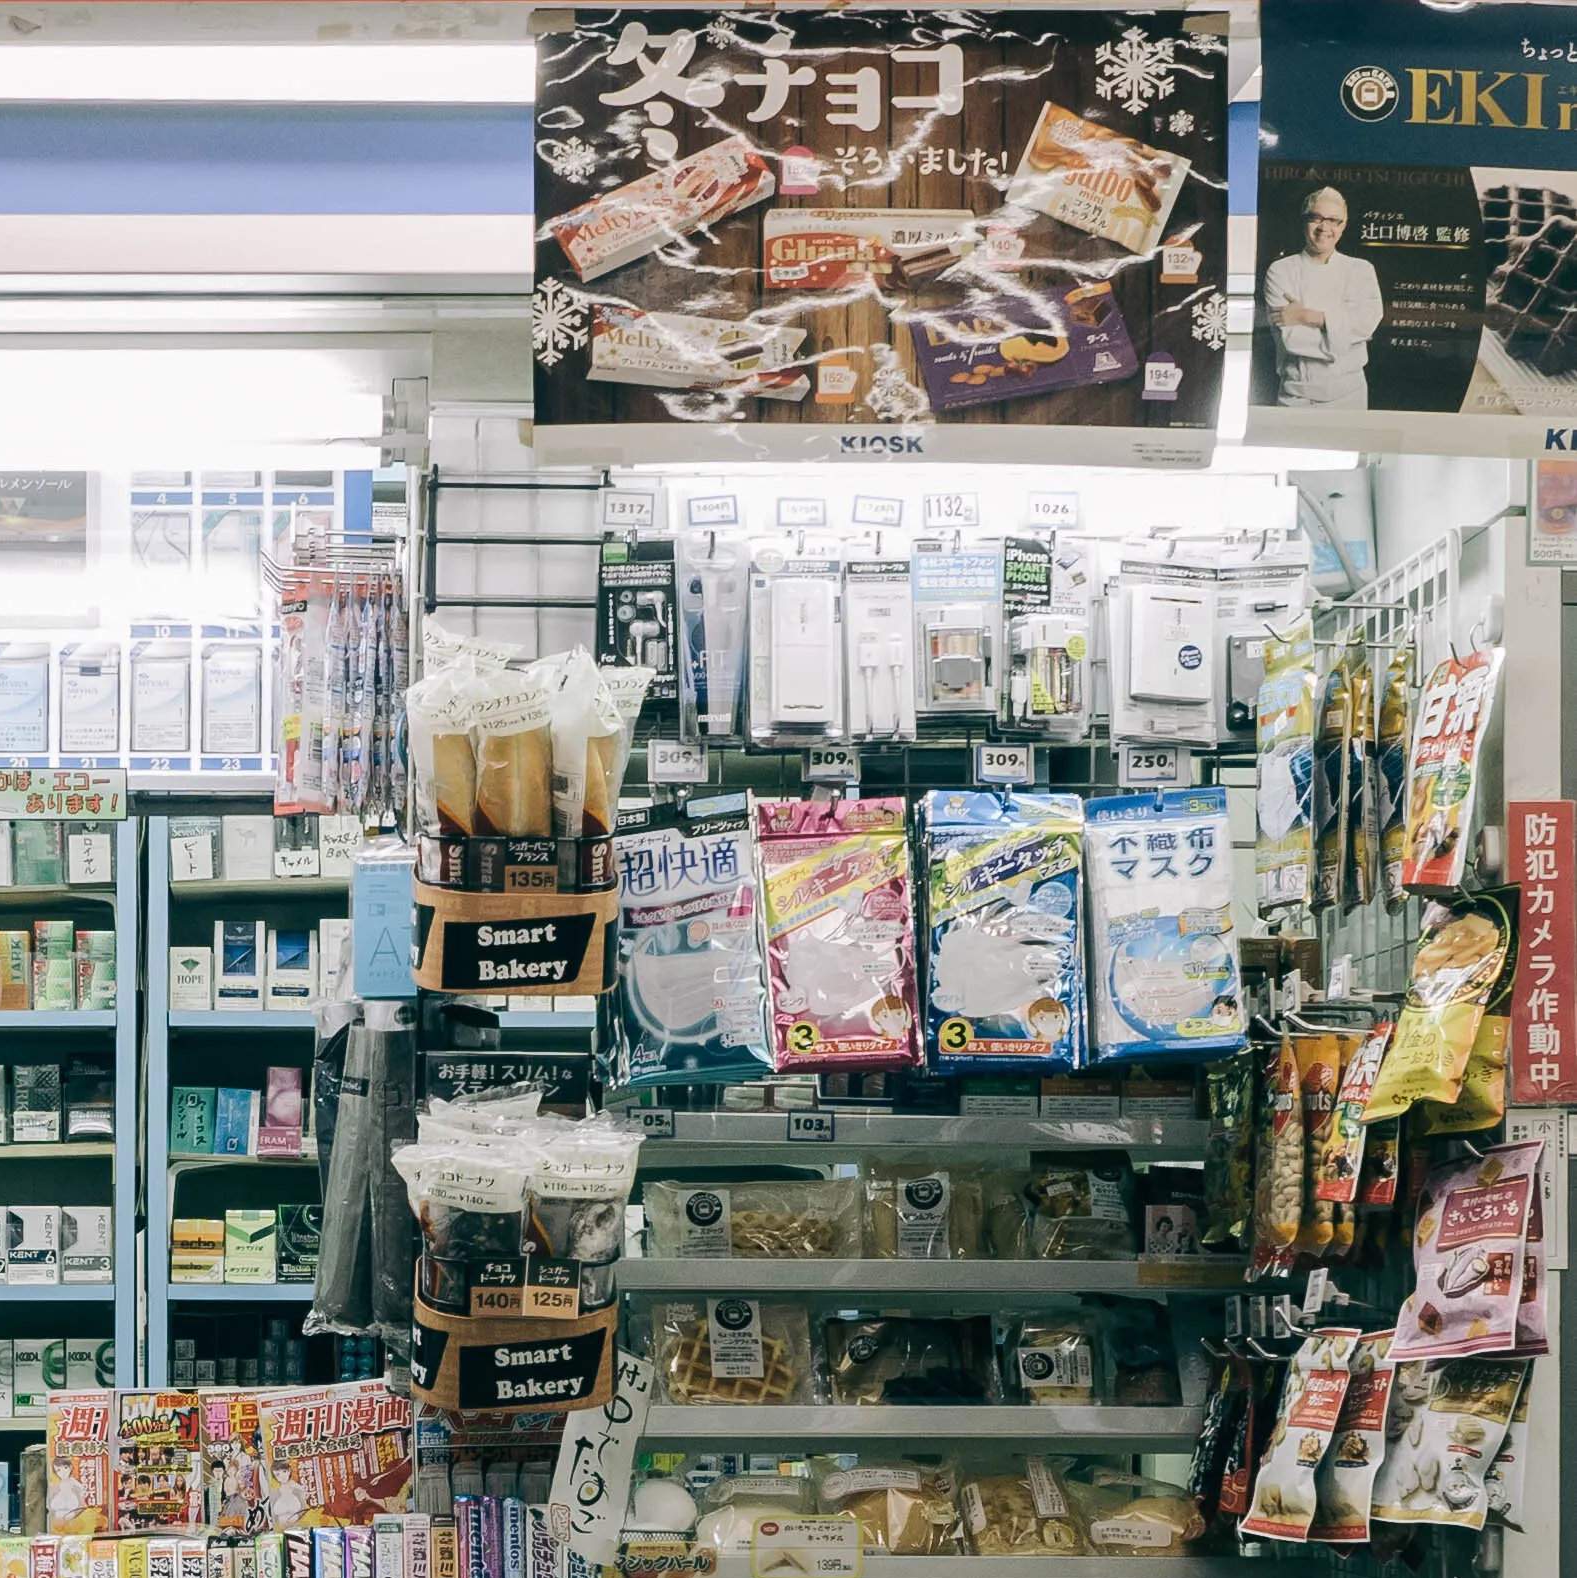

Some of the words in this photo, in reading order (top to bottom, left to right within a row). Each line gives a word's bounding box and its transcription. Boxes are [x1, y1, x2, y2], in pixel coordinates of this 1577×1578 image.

[599, 21, 965, 160] 冬チョコ
[1405, 68, 1550, 130] EKI
[1436, 226, 1470, 242] 監修
[841, 436, 924, 454] KIOSK
[1109, 827, 1215, 855] 不織布
[619, 837, 752, 900] 超快適
[1110, 854, 1215, 879] マスク
[510, 871, 555, 888] 135円
[478, 924, 557, 947] Smart
[1524, 813, 1560, 1089] 防犯カメラ作動中
[176, 974, 204, 985] HOPE
[479, 958, 568, 982] Bakery
[495, 1346, 572, 1368] Smart
[496, 1374, 583, 1399] Bakery
